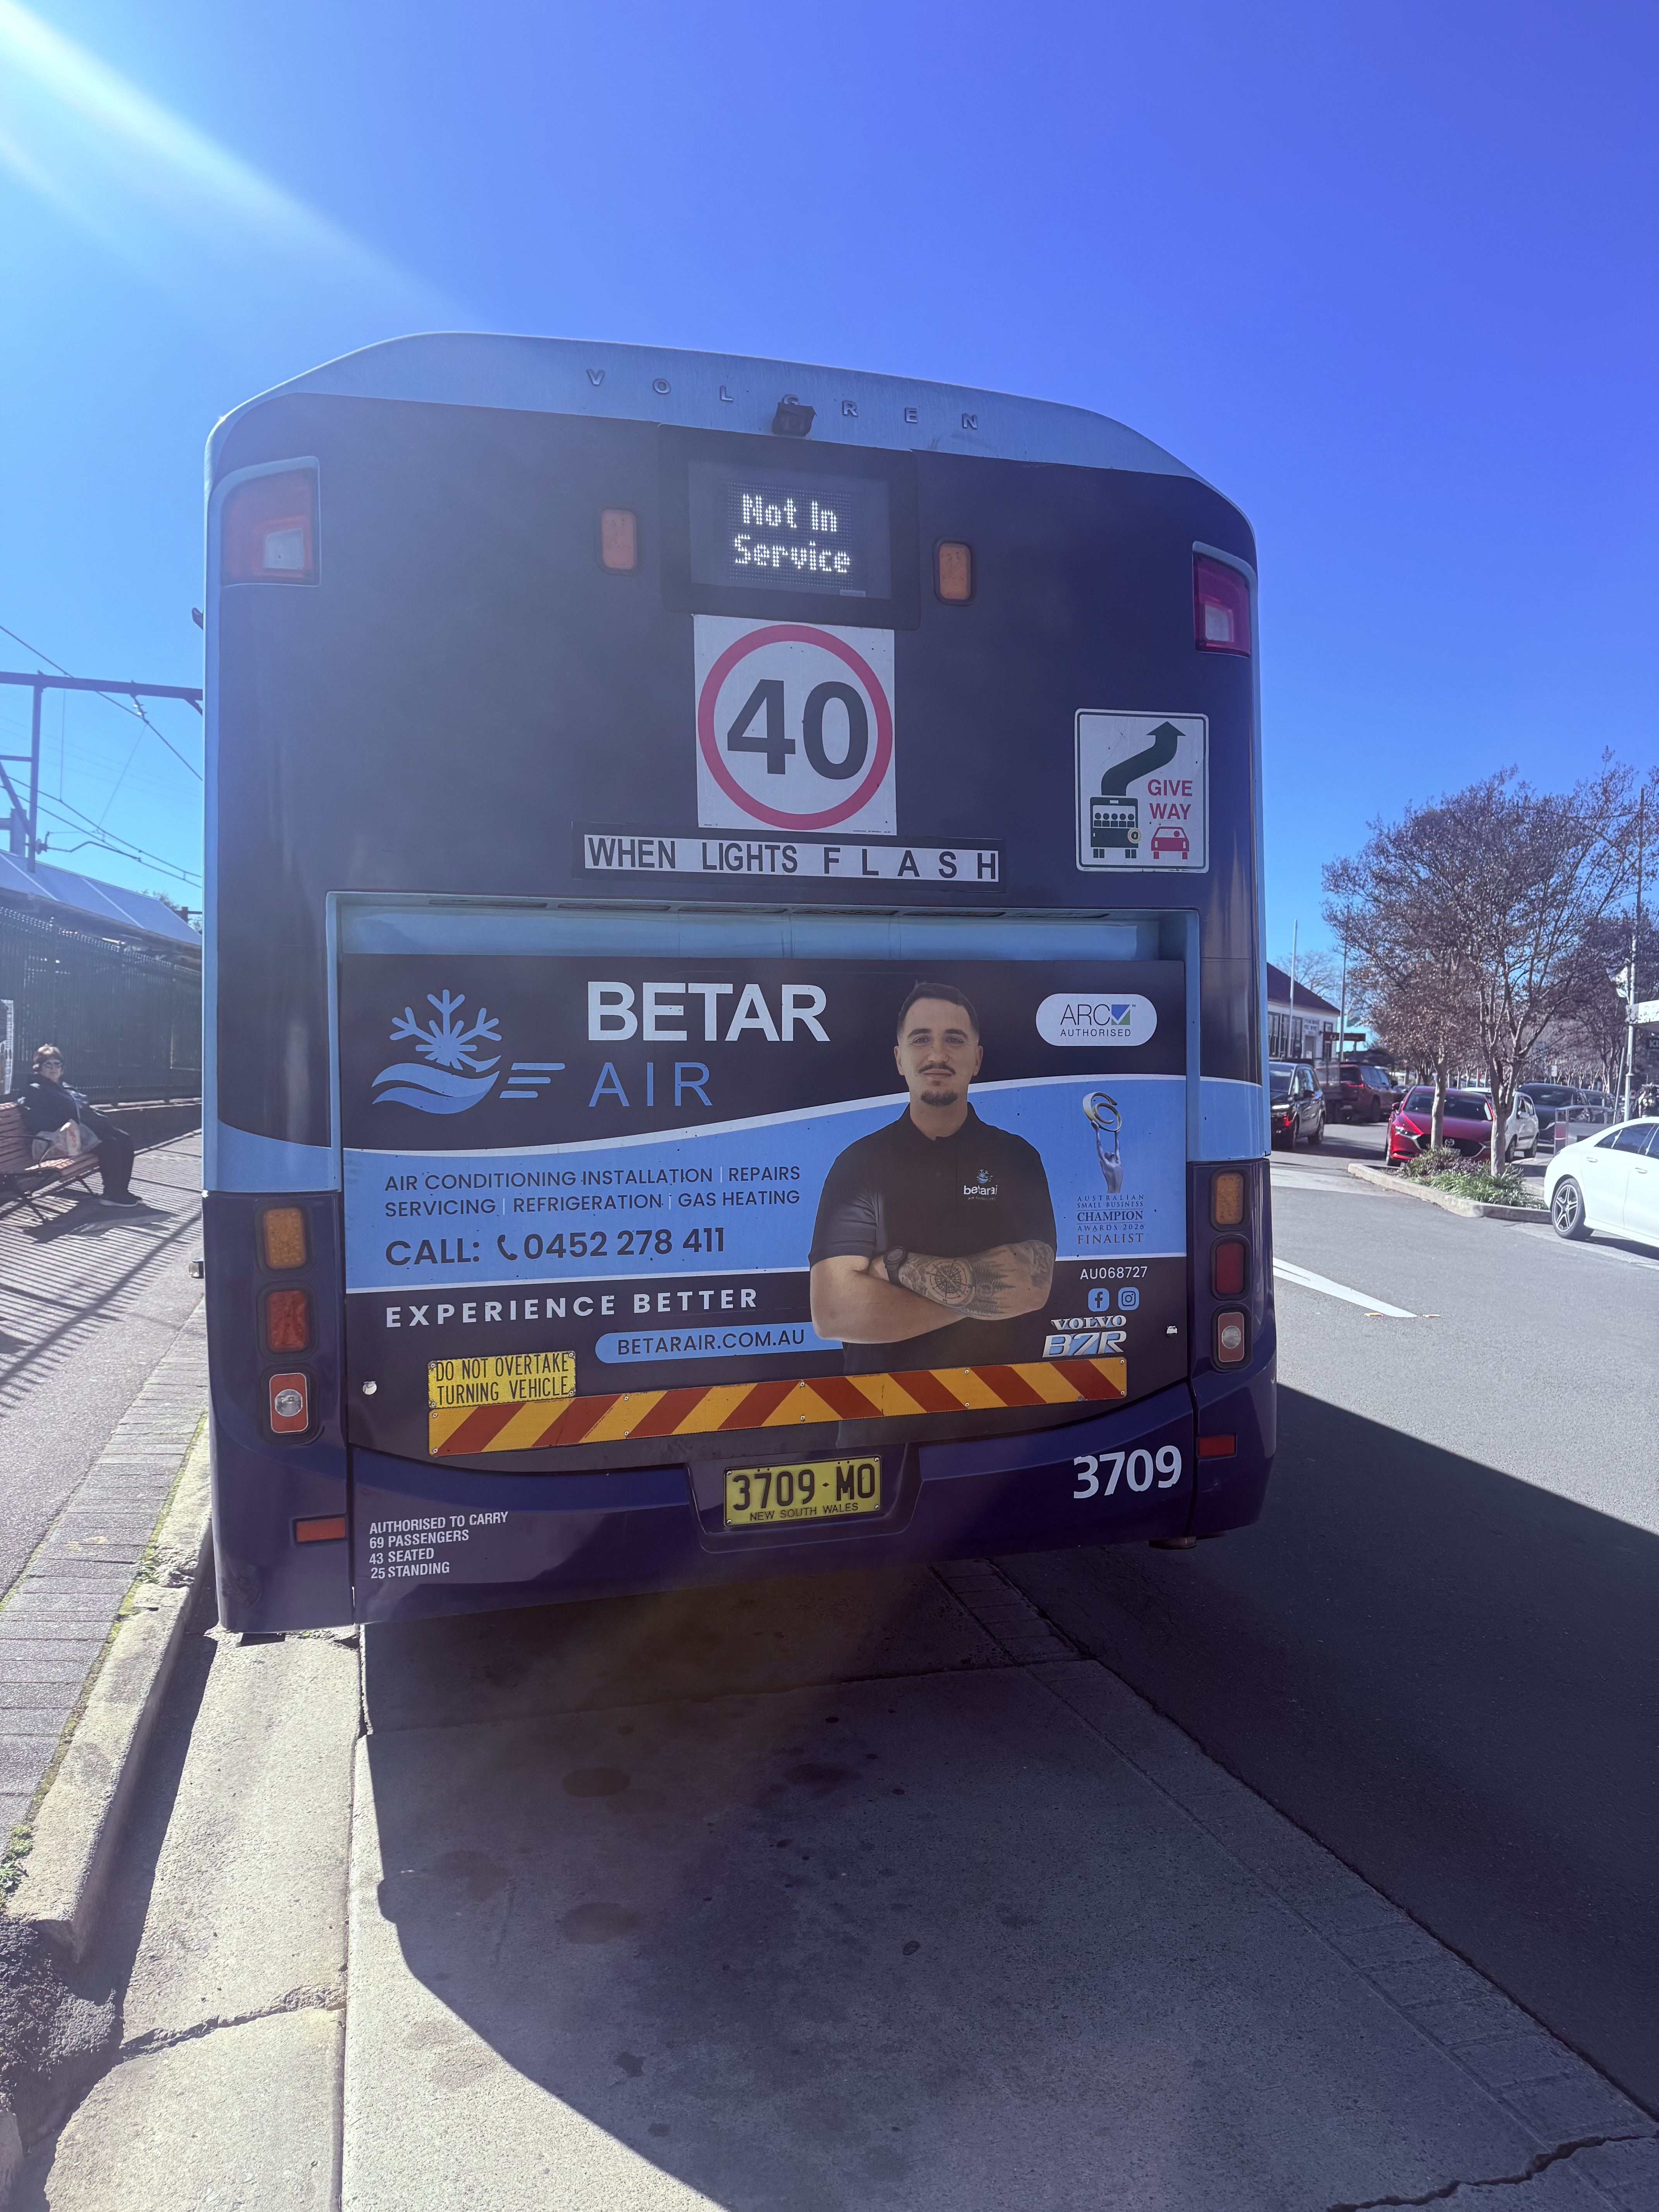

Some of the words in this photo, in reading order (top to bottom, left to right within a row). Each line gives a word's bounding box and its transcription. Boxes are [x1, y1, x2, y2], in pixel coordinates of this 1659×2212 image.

[743, 494, 797, 528] Not
[812, 501, 837, 532] In
[734, 534, 850, 573] Service
[726, 678, 869, 780] 40
[1147, 779, 1193, 797] GIVE
[1149, 803, 1191, 820] WAY
[588, 836, 677, 870] WHEN
[701, 842, 798, 873] LIGHTS
[587, 981, 831, 1041] BETAR
[1060, 1004, 1110, 1026] ARC
[588, 1061, 713, 1108] AIR
[385, 1175, 417, 1191] AIR
[425, 1171, 576, 1190] CONDITIONING
[582, 1168, 712, 1185] INSTALLATION
[729, 1166, 800, 1182] REPAIRS
[385, 1199, 496, 1217] SERVICING
[514, 1194, 662, 1212] REFRIGERATION
[678, 1192, 716, 1207] GAS
[723, 1190, 800, 1206] HEATING
[1077, 1211, 1143, 1222] CHAMPION
[385, 1238, 479, 1266] CALL:
[524, 1231, 608, 1260] 0452
[617, 1228, 672, 1255] 278
[682, 1227, 724, 1252] 411
[1077, 1233, 1144, 1244] FINALIST
[1080, 1266, 1148, 1280] AU068727
[386, 1295, 616, 1328] EXPERIENCE
[633, 1288, 758, 1314] BETTER
[1051, 1315, 1127, 1331] VOLVO
[618, 1329, 805, 1357] BETARAIR.COM.AU
[1042, 1331, 1127, 1358] B7R
[435, 1361, 454, 1382] DO
[462, 1358, 488, 1380] NOT
[495, 1353, 569, 1377] OVERTAKE
[436, 1382, 499, 1405] TURNING
[509, 1376, 568, 1400] VEHICLE
[1073, 1445, 1182, 1499] 3709
[369, 1516, 446, 1534] AUTHORISED
[449, 1515, 465, 1527] TO
[469, 1511, 508, 1526] CARRY
[750, 1510, 775, 1521] NEW
[780, 1506, 817, 1518] SOUTH
[823, 1502, 859, 1514] WALES
[369, 1537, 384, 1549] 69
[388, 1529, 469, 1547] PASSENGERS
[369, 1553, 384, 1565] 43
[388, 1547, 434, 1563] SEATED
[371, 1567, 385, 1579] 25
[388, 1561, 450, 1578] STANDING
